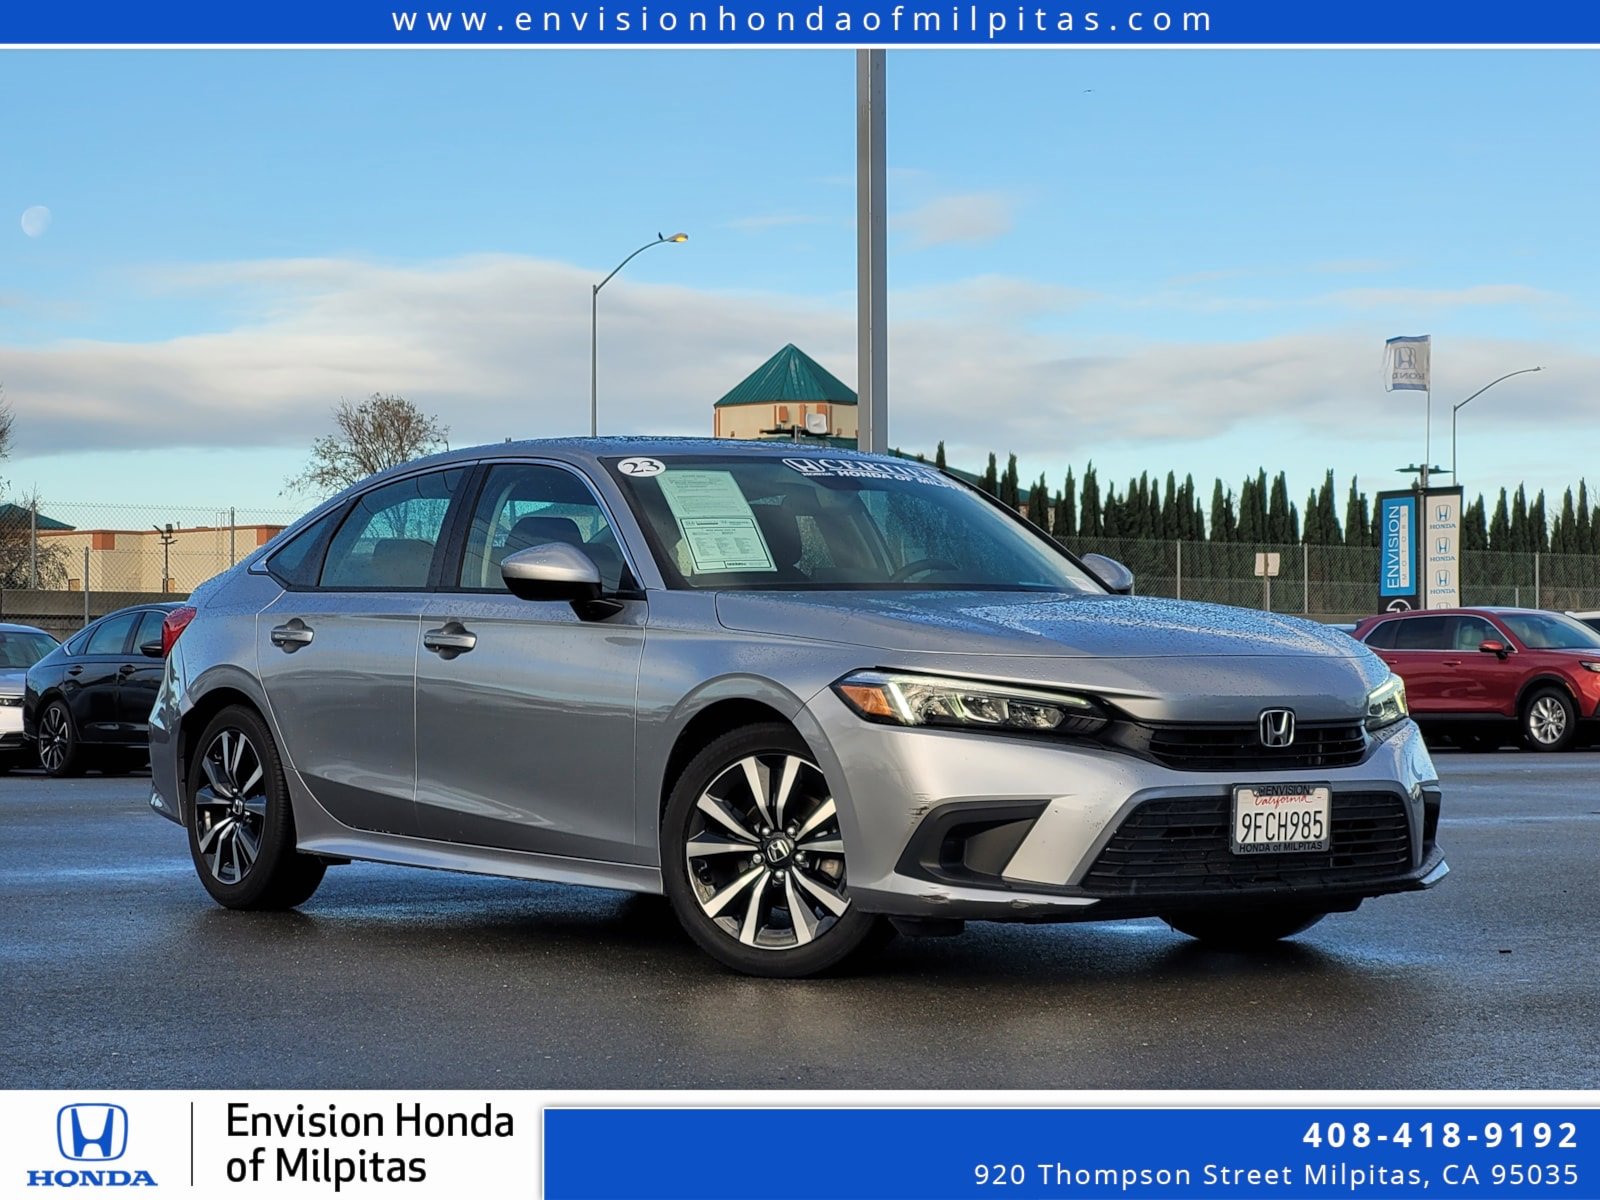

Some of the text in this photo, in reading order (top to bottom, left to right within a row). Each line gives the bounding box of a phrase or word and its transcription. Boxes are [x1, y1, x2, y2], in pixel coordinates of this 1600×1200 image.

[623, 460, 660, 474] 23
[837, 470, 892, 479] HONDA
[1387, 506, 1400, 588] ENVISION
[1265, 785, 1310, 795] ENVISION
[1254, 795, 1313, 809] California
[1240, 810, 1324, 843] 9FCH985
[1239, 841, 1323, 853] HONDA of MILPITAS
